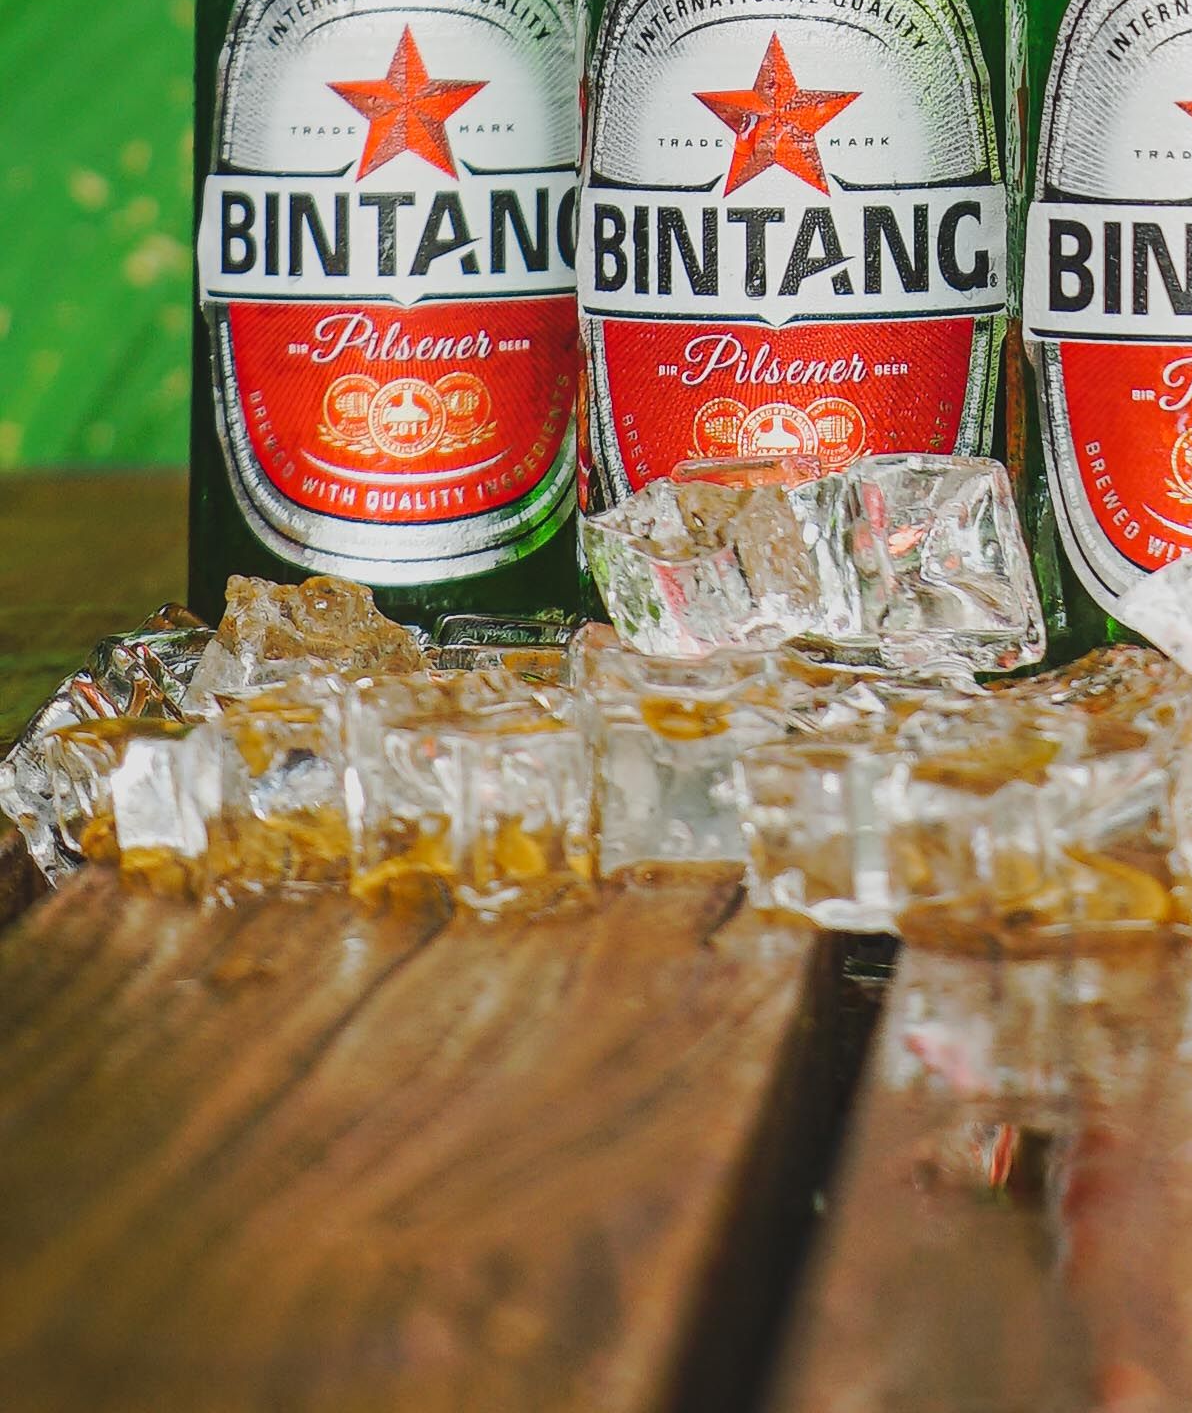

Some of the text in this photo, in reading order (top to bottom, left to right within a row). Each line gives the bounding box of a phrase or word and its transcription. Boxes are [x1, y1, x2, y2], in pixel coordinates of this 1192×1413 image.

[290, 123, 515, 134] TRADE MARK
[658, 135, 891, 148] TRADE MARK
[594, 201, 989, 298] BINTANG
[288, 312, 530, 364] BIR Pilsener BEER
[658, 333, 909, 386] BIR Pilsener BEER
[1131, 389, 1156, 402] BIR
[302, 476, 356, 506] WITH
[366, 486, 466, 512] QUALITY
[477, 374, 570, 500] INGREDIENTS
[389, 421, 428, 437] 2011
[622, 413, 651, 477] BREW
[1085, 441, 1141, 541] BREWED
[1148, 534, 1191, 562] WIT
